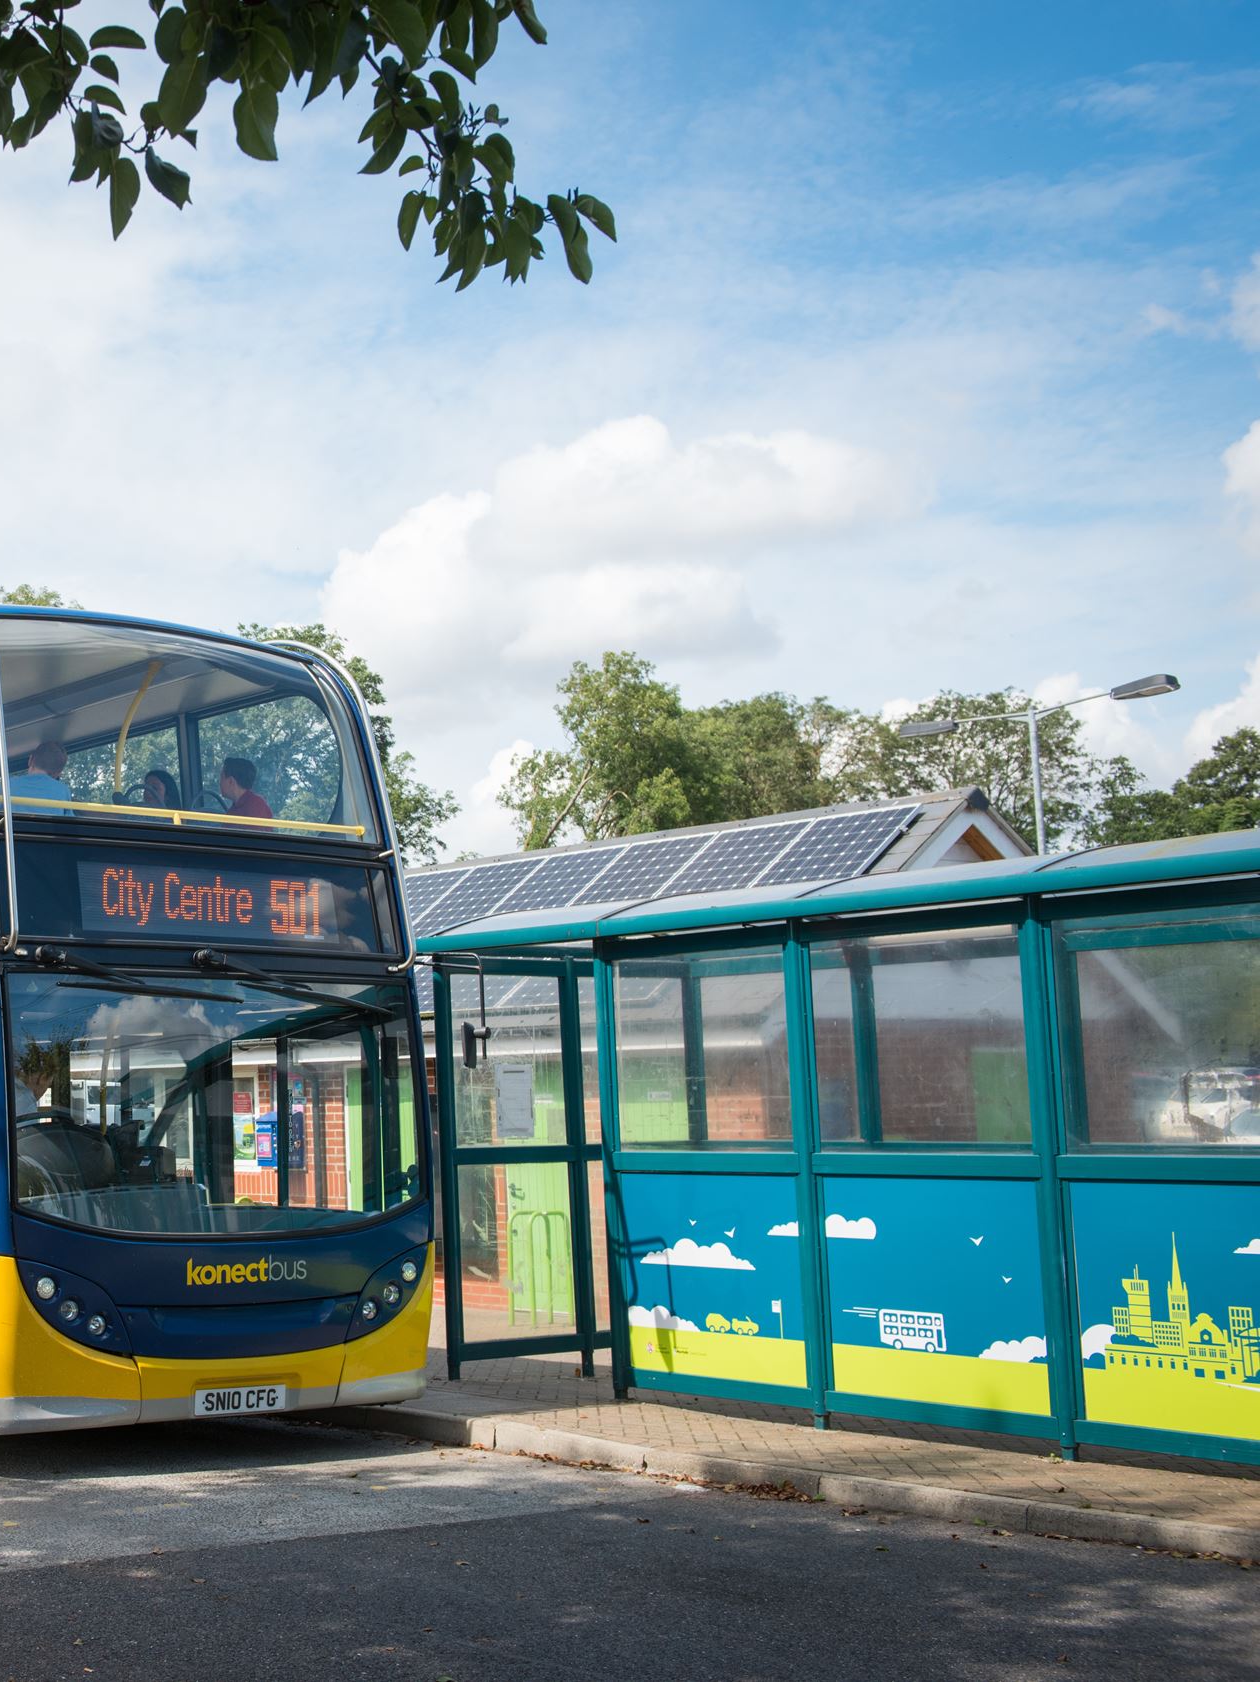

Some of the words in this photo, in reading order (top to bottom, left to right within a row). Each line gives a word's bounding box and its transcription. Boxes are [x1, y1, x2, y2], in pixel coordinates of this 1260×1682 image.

[102, 867, 154, 926] City
[164, 872, 253, 924] Centre
[270, 879, 320, 936] 501
[186, 1253, 307, 1286] konectbus
[204, 1390, 241, 1412] SN10
[246, 1388, 277, 1409] CFG
